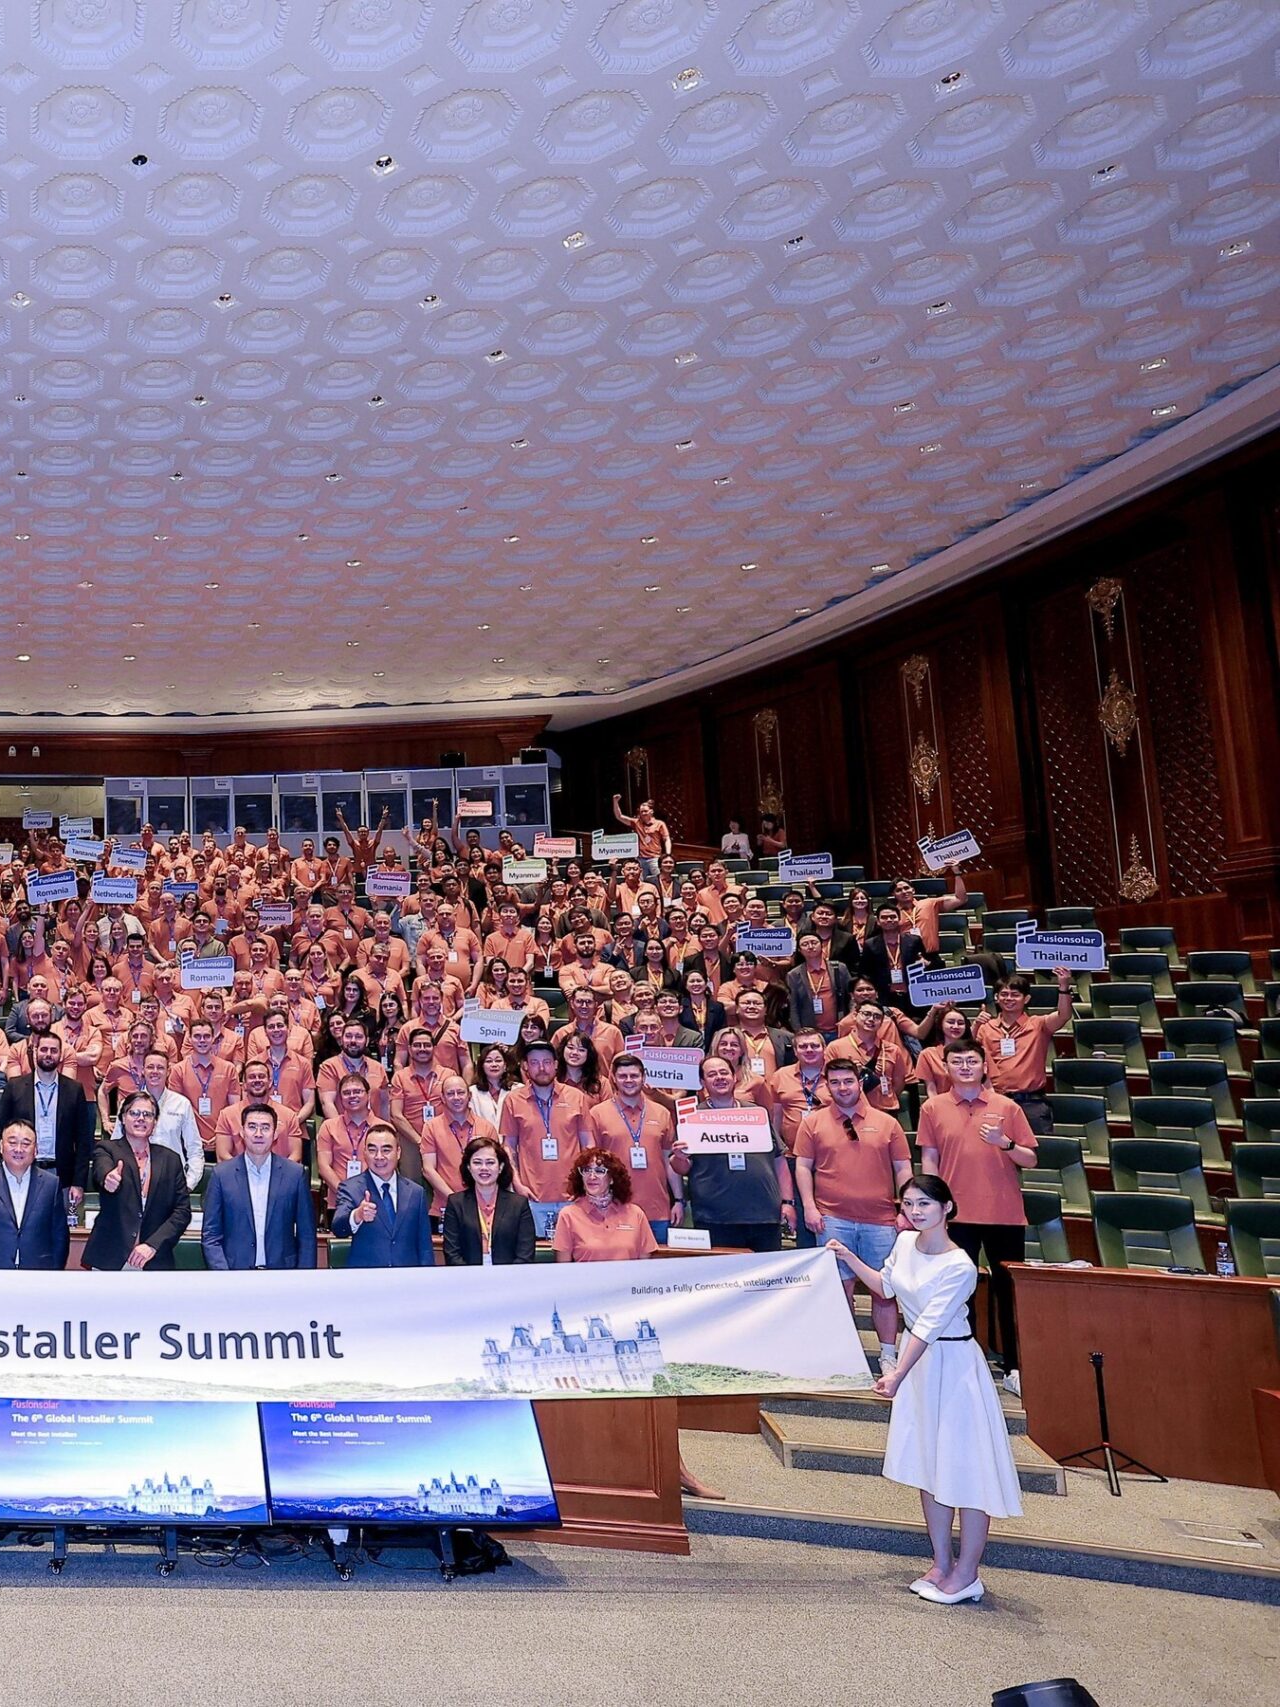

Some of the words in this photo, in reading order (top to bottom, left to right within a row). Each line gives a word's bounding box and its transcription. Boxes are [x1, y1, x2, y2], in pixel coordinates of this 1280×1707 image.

[598, 846, 632, 855] Myanmar
[934, 847, 969, 863] Thailand
[508, 872, 540, 880] Myanmar
[788, 868, 823, 877] Thailand
[36, 887, 69, 897] Romania
[373, 884, 402, 892] Romania
[94, 890, 134, 899] Netherlands
[1037, 934, 1095, 944] Fusionsolar
[746, 943, 782, 951] Thailand
[1031, 951, 1088, 963] Thailand
[190, 973, 225, 982] Romania
[926, 970, 976, 981] Fusionsolar
[923, 985, 972, 998] Thailand
[479, 1026, 507, 1037] Spain
[644, 1050, 697, 1062] Fusionsolar
[643, 1067, 683, 1080] Austria
[699, 1113, 760, 1123] Fusionsolar
[700, 1132, 749, 1143] Austria
[631, 1286, 664, 1295] Building
[673, 1283, 692, 1294] Fully
[694, 1280, 742, 1291] Connected,
[743, 1276, 783, 1287] Intelligent
[784, 1274, 810, 1284] World
[159, 1320, 344, 1360] Summit
[11, 1400, 59, 1409] Fusionsolar
[12, 1413, 29, 1422] The
[45, 1414, 75, 1423] Global
[77, 1415, 115, 1423] Installer
[118, 1415, 154, 1424] Summit
[291, 1413, 308, 1422] The
[324, 1413, 354, 1423] Global
[356, 1414, 393, 1423] Installer
[396, 1414, 432, 1424] Summit
